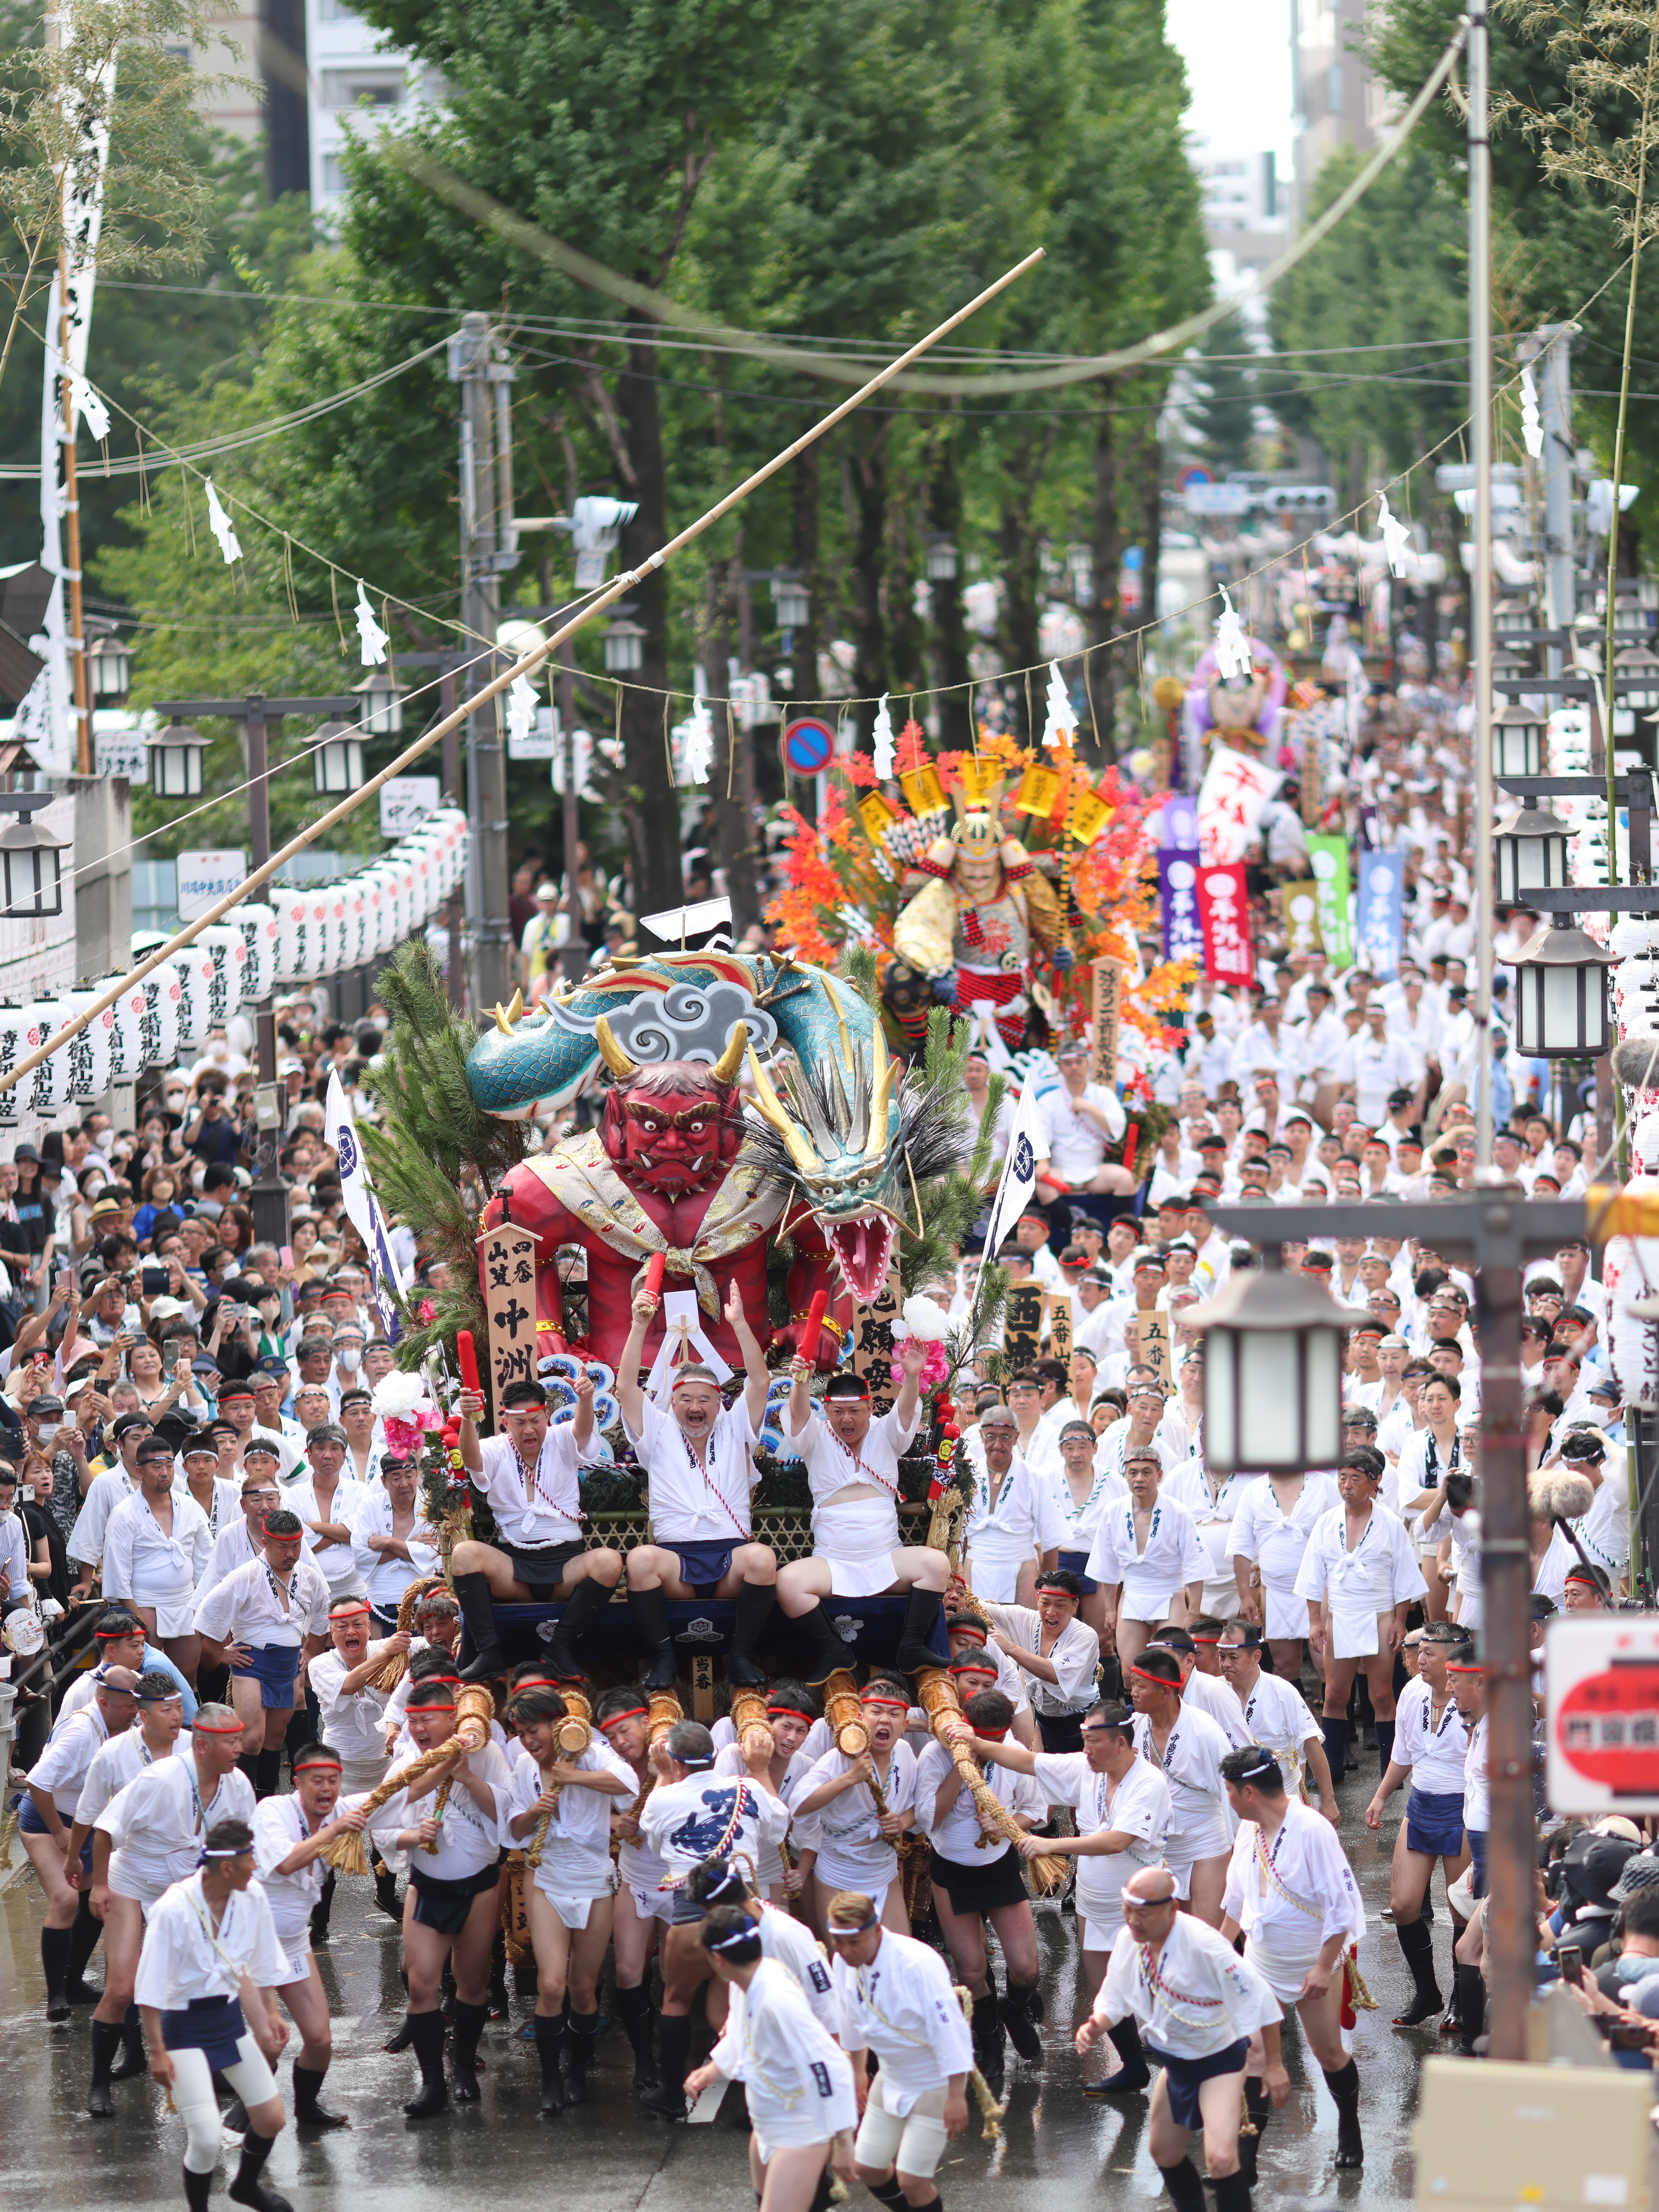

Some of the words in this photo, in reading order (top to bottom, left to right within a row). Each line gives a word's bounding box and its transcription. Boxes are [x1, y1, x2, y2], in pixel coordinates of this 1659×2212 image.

[488, 1241, 512, 1290] 山笠
[512, 1241, 534, 1284] 四番
[493, 1298, 534, 1434] 中洲
[694, 1657, 712, 1690] 当番
